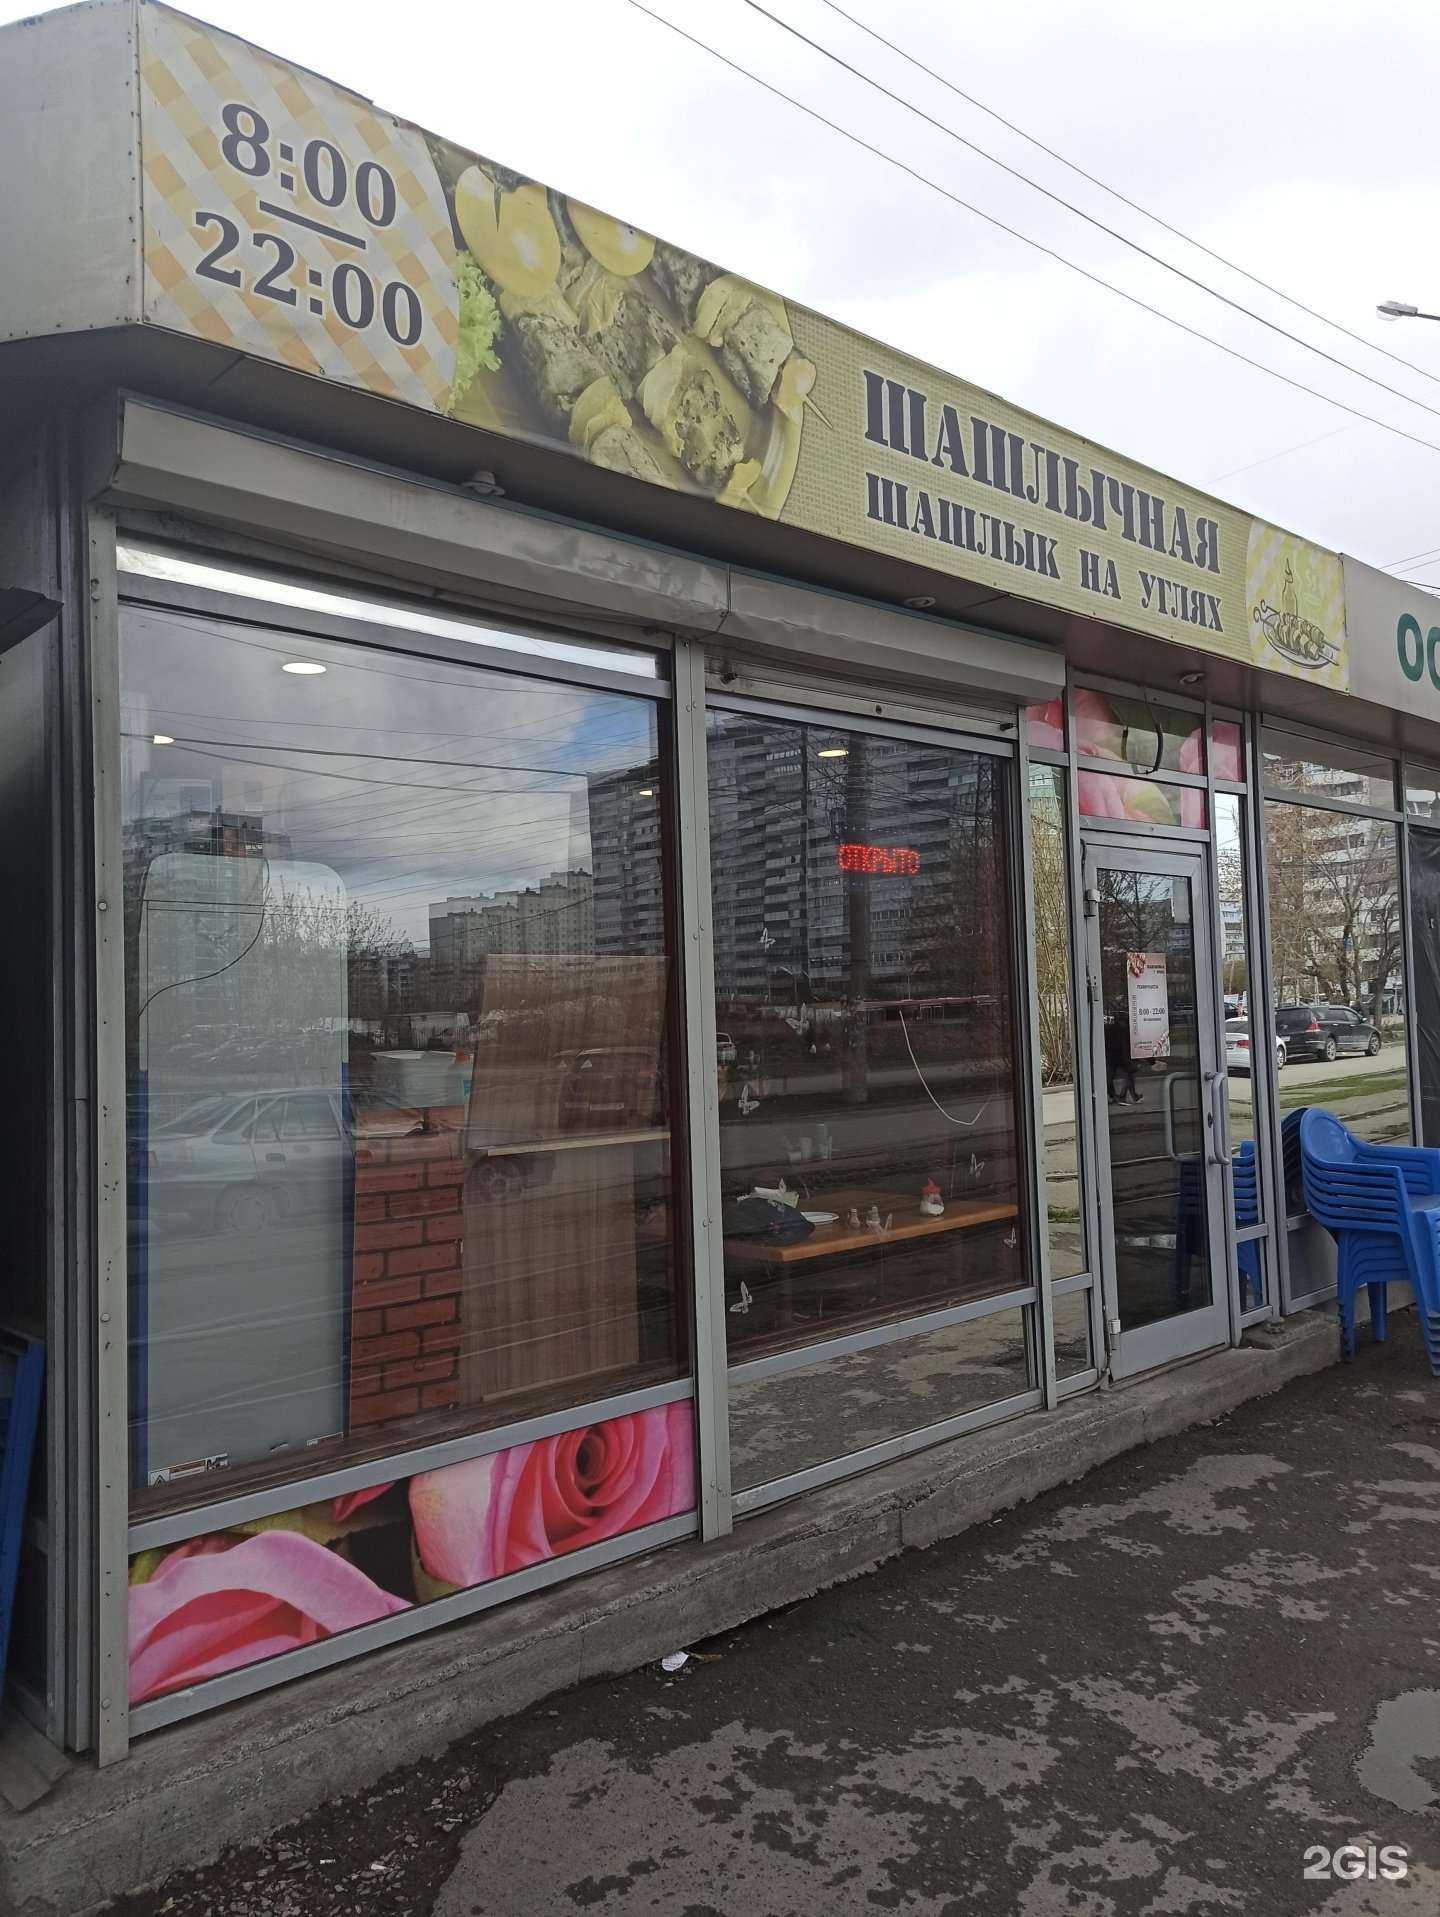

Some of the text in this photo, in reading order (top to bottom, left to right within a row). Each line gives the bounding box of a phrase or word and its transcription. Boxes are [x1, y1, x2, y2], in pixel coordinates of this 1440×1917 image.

[222, 103, 396, 227] 8:00
[195, 211, 422, 346] 22:00
[863, 370, 1220, 573] ШАШЛЫЧНАЯ
[866, 473, 1224, 633] ШАШЛЫК НА УГЛЯХ
